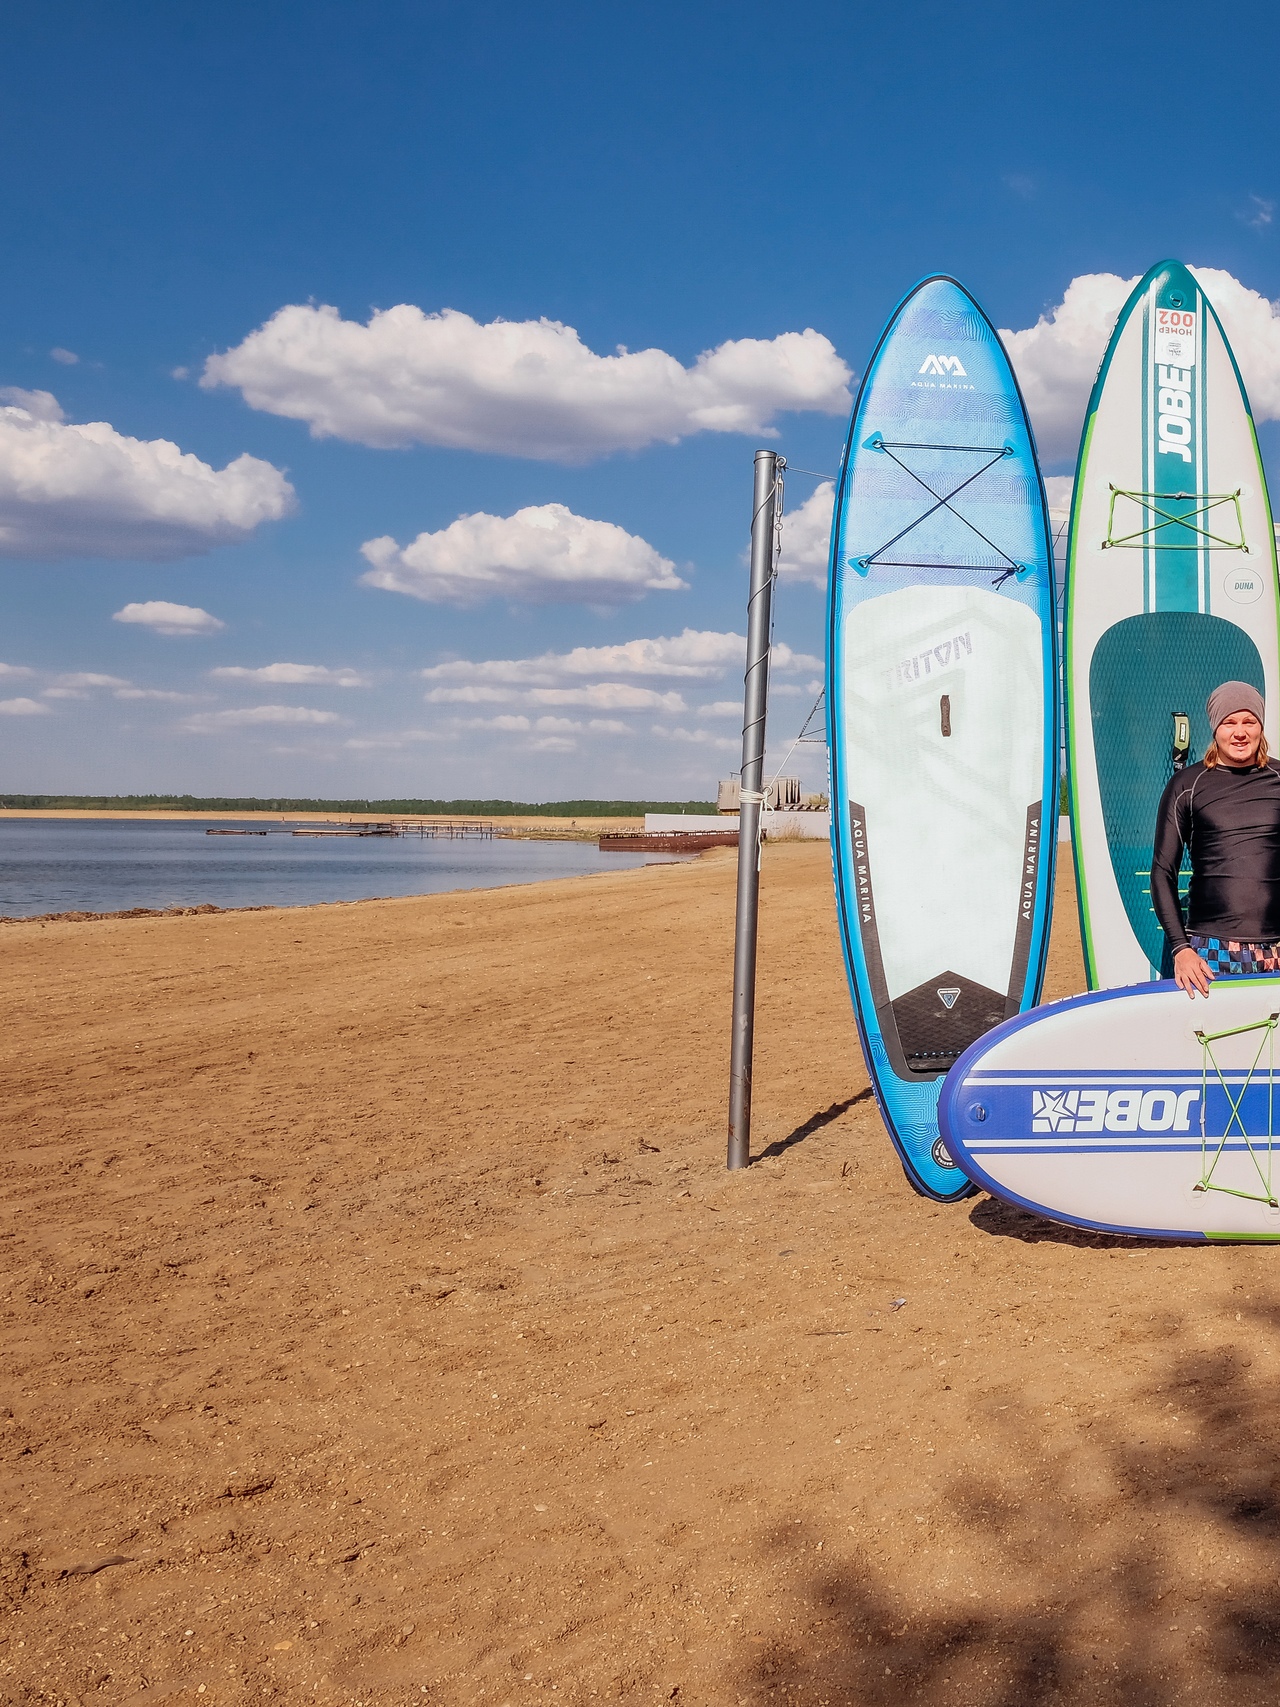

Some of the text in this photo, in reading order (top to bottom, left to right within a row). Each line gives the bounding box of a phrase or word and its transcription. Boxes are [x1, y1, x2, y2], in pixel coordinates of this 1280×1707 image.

[1159, 311, 1193, 327] 002
[1158, 364, 1192, 463] JOBE
[1234, 582, 1254, 590] DUNA
[853, 819, 872, 923] AQUA MARINA
[1022, 818, 1039, 920] AQUA MARINA
[1075, 1089, 1201, 1132] JOBE
